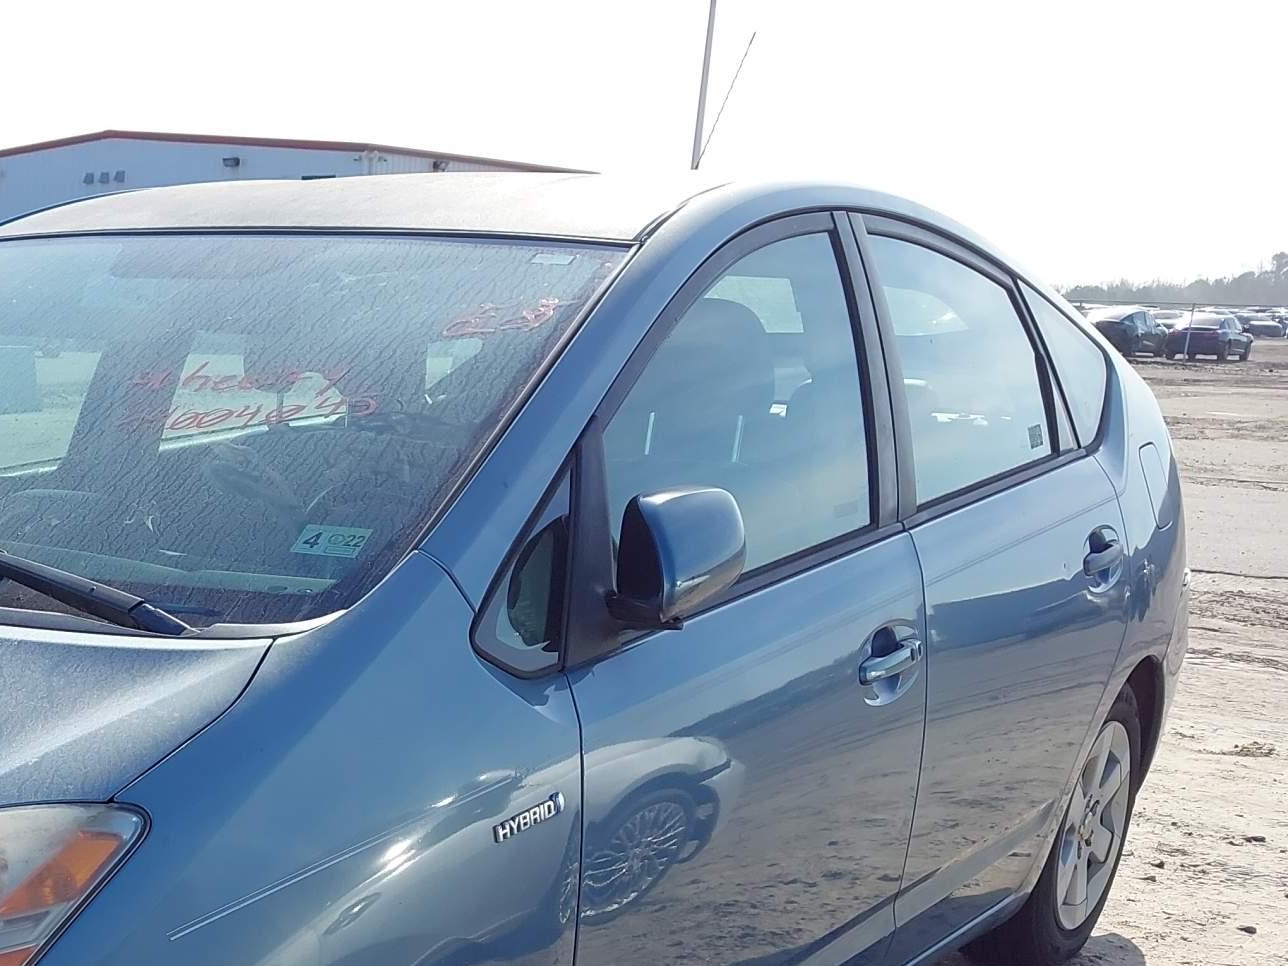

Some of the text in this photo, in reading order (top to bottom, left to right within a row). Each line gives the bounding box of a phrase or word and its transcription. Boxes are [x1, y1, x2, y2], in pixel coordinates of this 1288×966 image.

[302, 531, 366, 549] 4 22
[496, 799, 557, 843] HYBRID
